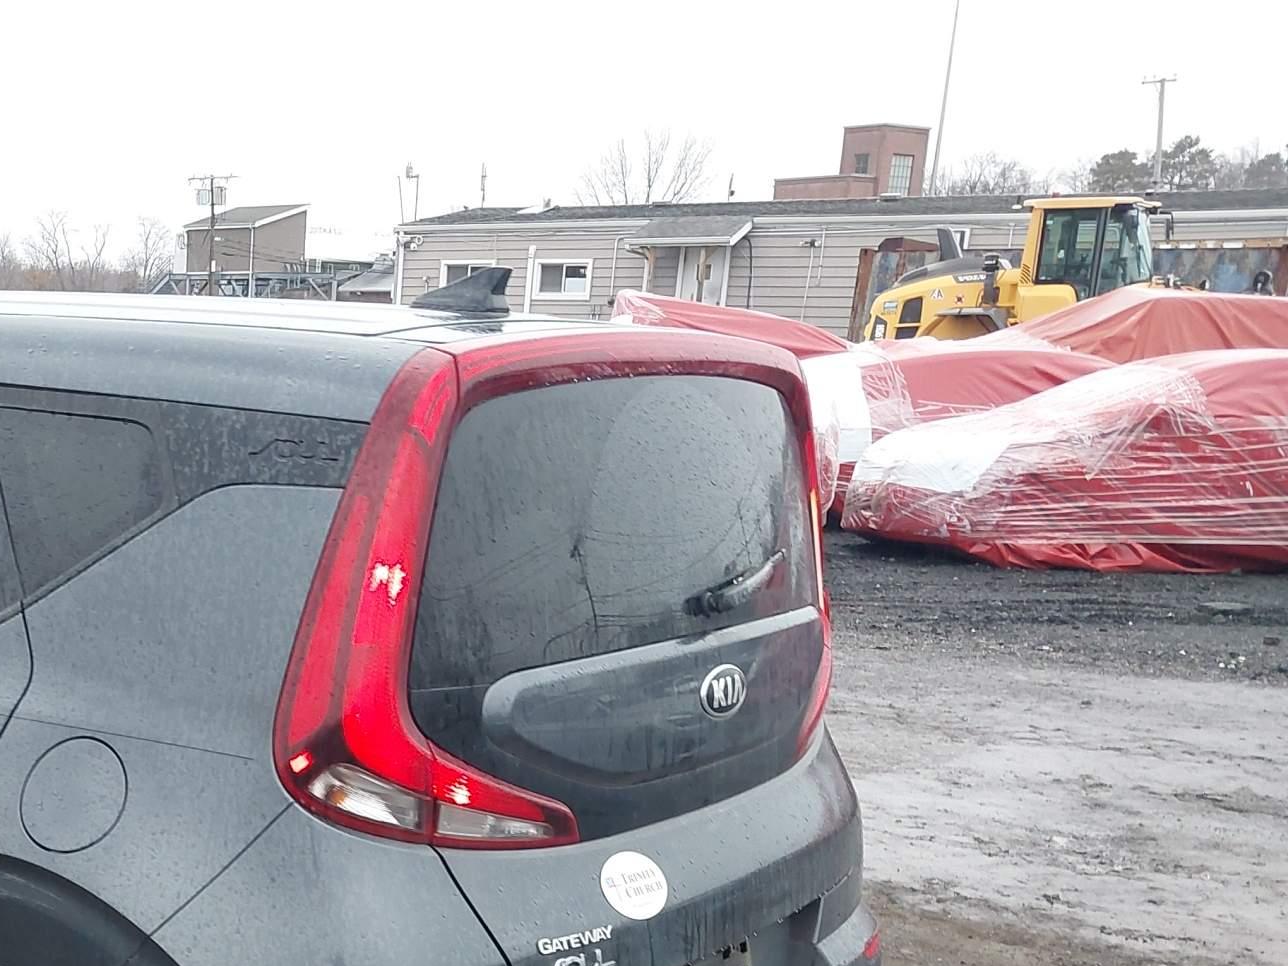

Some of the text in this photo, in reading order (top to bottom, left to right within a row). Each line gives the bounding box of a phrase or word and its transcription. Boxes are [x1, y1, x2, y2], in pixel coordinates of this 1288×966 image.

[711, 673, 745, 709] KIA
[620, 867, 656, 885] TRINITY
[624, 880, 663, 899] CHURCH
[537, 924, 613, 955] GATEWAY
